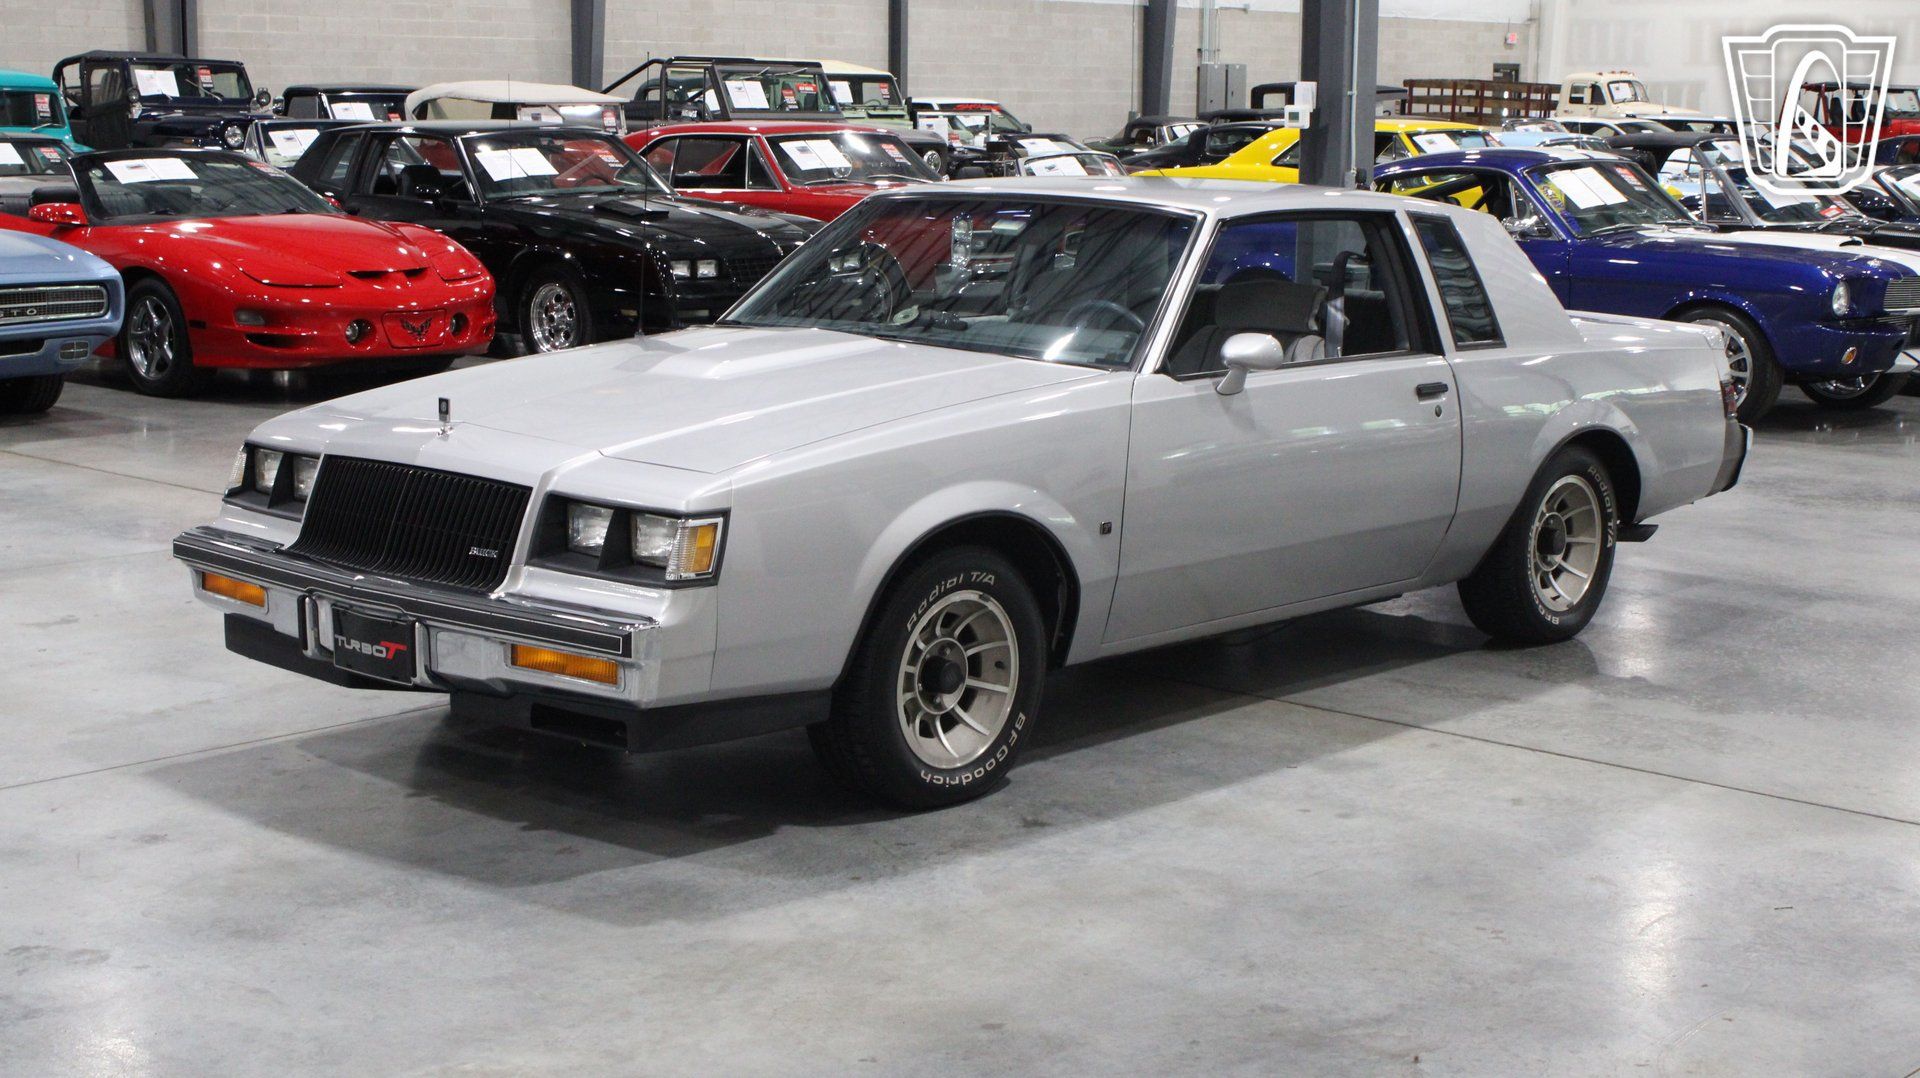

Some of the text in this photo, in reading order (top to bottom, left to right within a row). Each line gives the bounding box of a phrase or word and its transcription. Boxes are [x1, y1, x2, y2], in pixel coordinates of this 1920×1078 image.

[1587, 466, 1615, 548] Radial T/A
[906, 571, 996, 633] Radial T/A
[920, 712, 1026, 788] BFGoodrich
